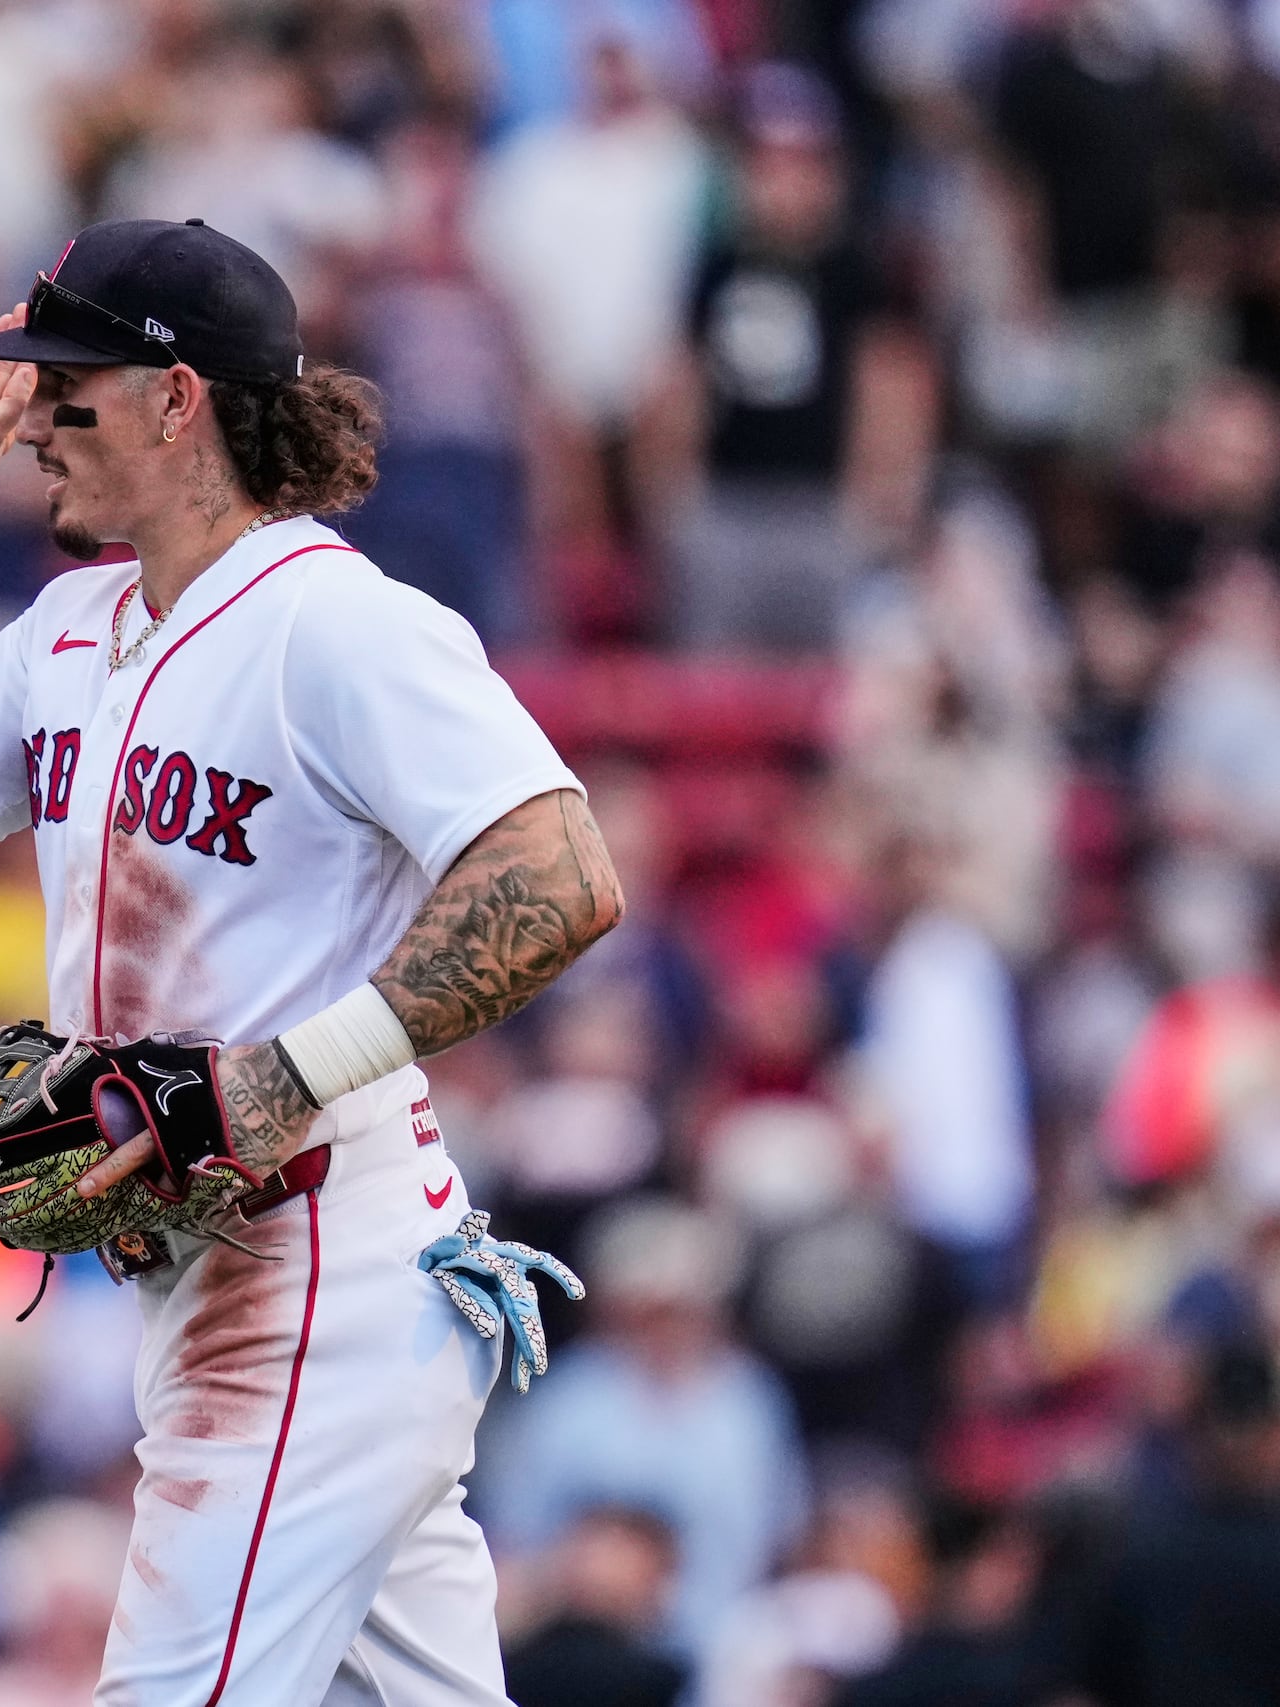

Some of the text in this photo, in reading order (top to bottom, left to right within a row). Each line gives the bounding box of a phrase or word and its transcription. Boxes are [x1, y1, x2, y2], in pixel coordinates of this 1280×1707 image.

[22, 727, 273, 867] ED SOX
[222, 1077, 262, 1118] NOT
[252, 1118, 285, 1153] BE
